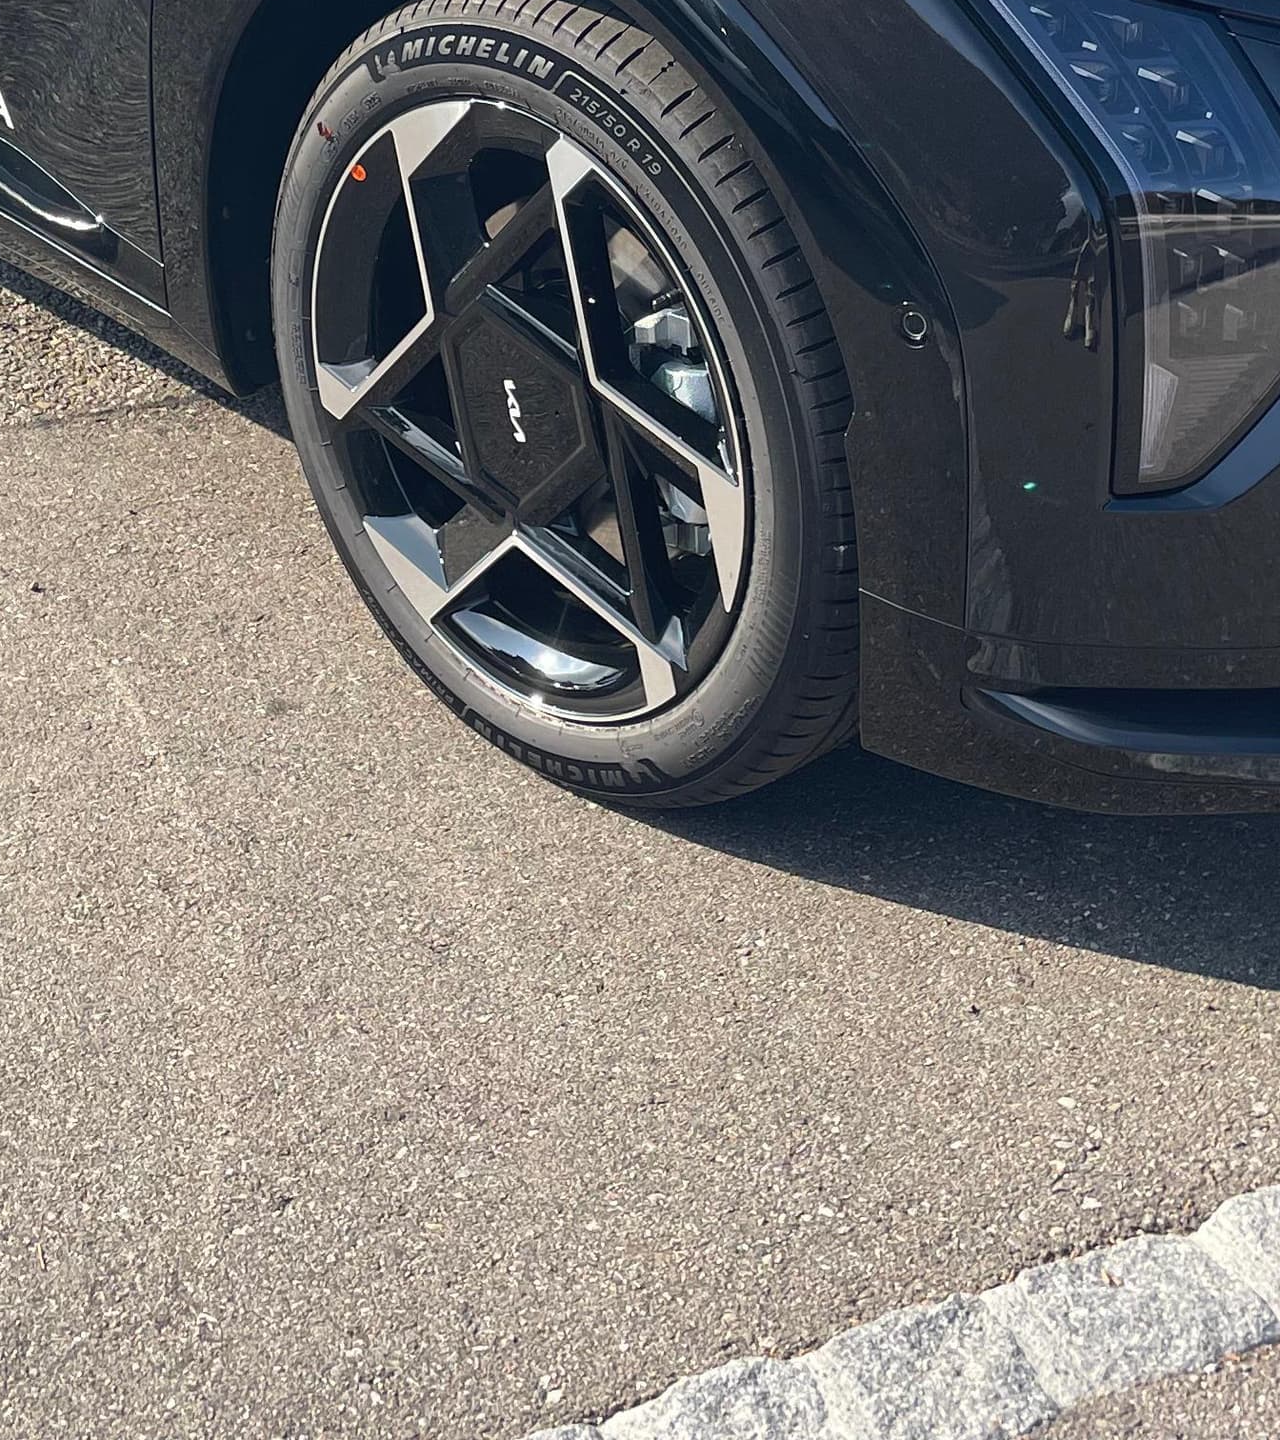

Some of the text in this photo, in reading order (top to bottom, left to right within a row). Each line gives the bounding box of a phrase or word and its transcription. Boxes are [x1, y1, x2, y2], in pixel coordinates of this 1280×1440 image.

[401, 34, 556, 80] MICHELIN
[569, 88, 662, 176] 215/50 R 19
[474, 717, 628, 788] MICHELIN
